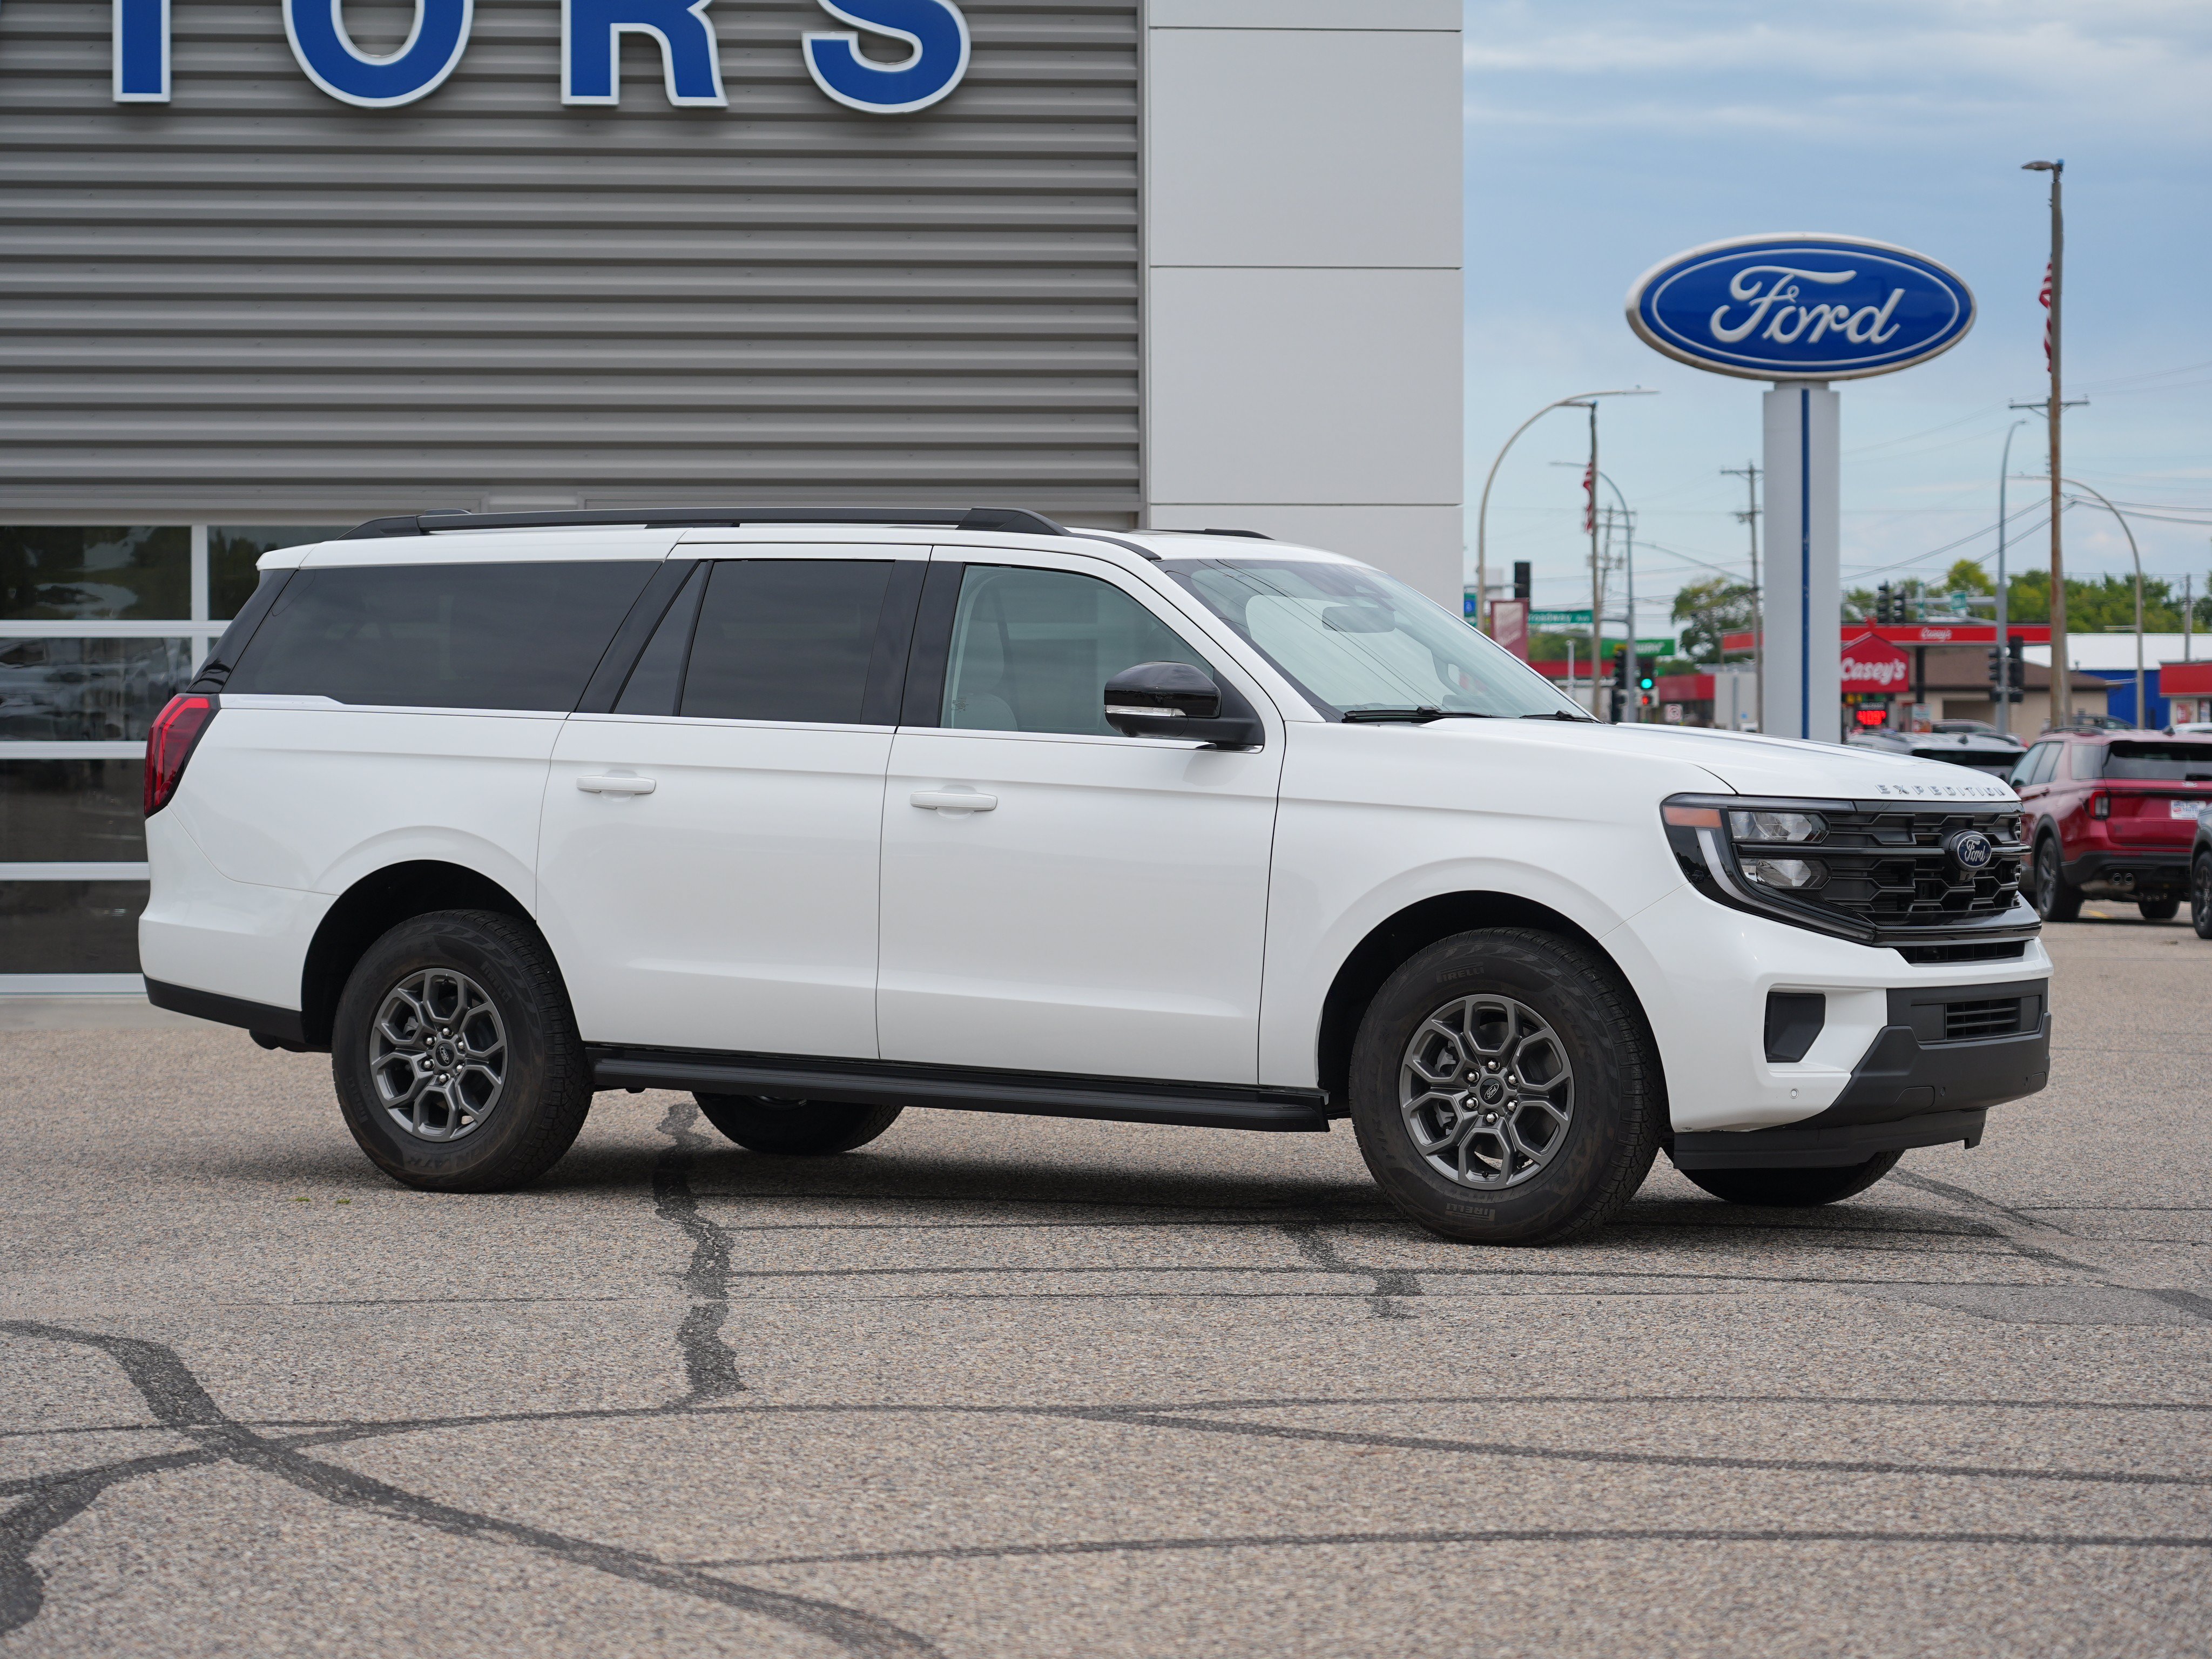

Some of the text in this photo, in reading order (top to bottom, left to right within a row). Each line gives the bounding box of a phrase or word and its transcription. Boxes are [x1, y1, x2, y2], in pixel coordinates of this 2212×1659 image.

[1710, 265, 1905, 345] Ford
[1528, 612, 1572, 623] roadway
[1920, 626, 1952, 642] Casey's
[1842, 657, 1906, 685] Casey's
[1874, 784, 2006, 797] EXPEDITION
[1964, 839, 1986, 862] Ford
[1437, 962, 1485, 983] PIRELLI
[1486, 1085, 1496, 1098] Ford
[1445, 1203, 1496, 1222] PIRELLI
